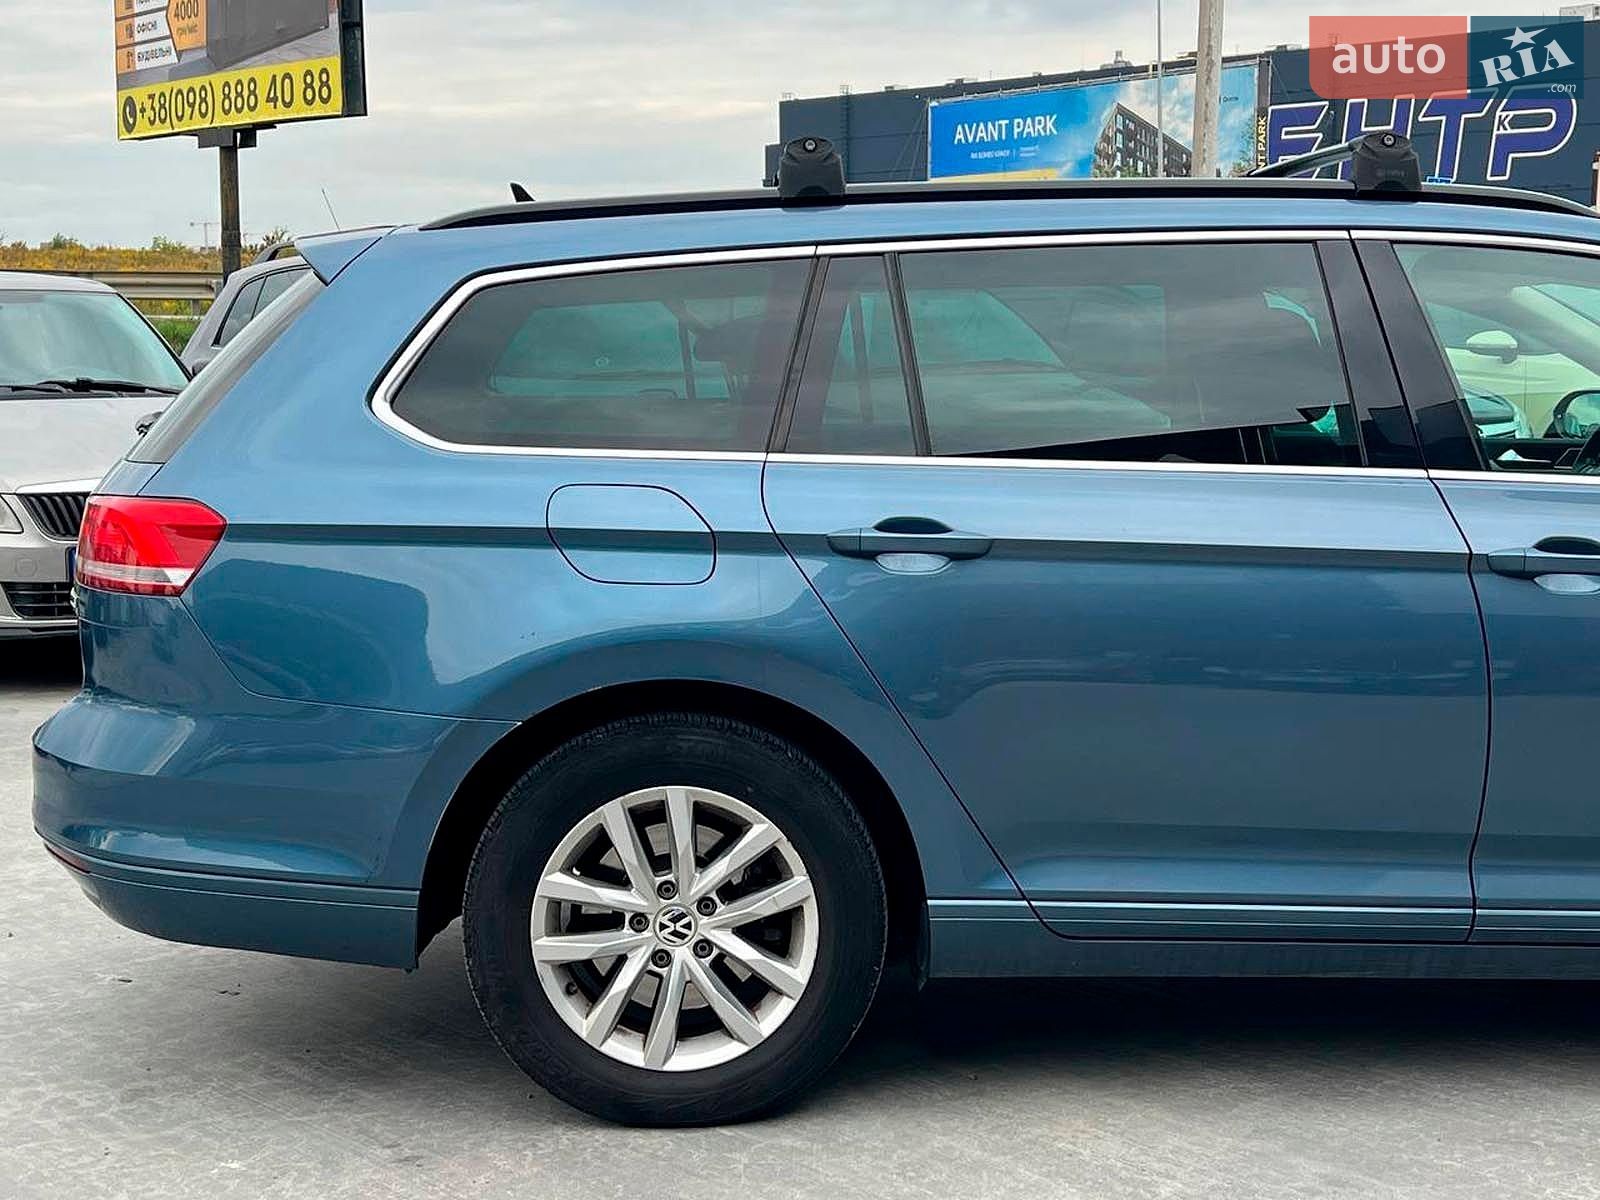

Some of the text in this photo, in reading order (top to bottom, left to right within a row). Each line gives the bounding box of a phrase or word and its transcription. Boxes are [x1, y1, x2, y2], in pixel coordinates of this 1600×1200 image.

[174, 0, 199, 20] 4000
[139, 67, 332, 130] +38(098) 888 40 88
[954, 113, 1058, 145] AVANT PARK
[1257, 115, 1267, 152] PARK
